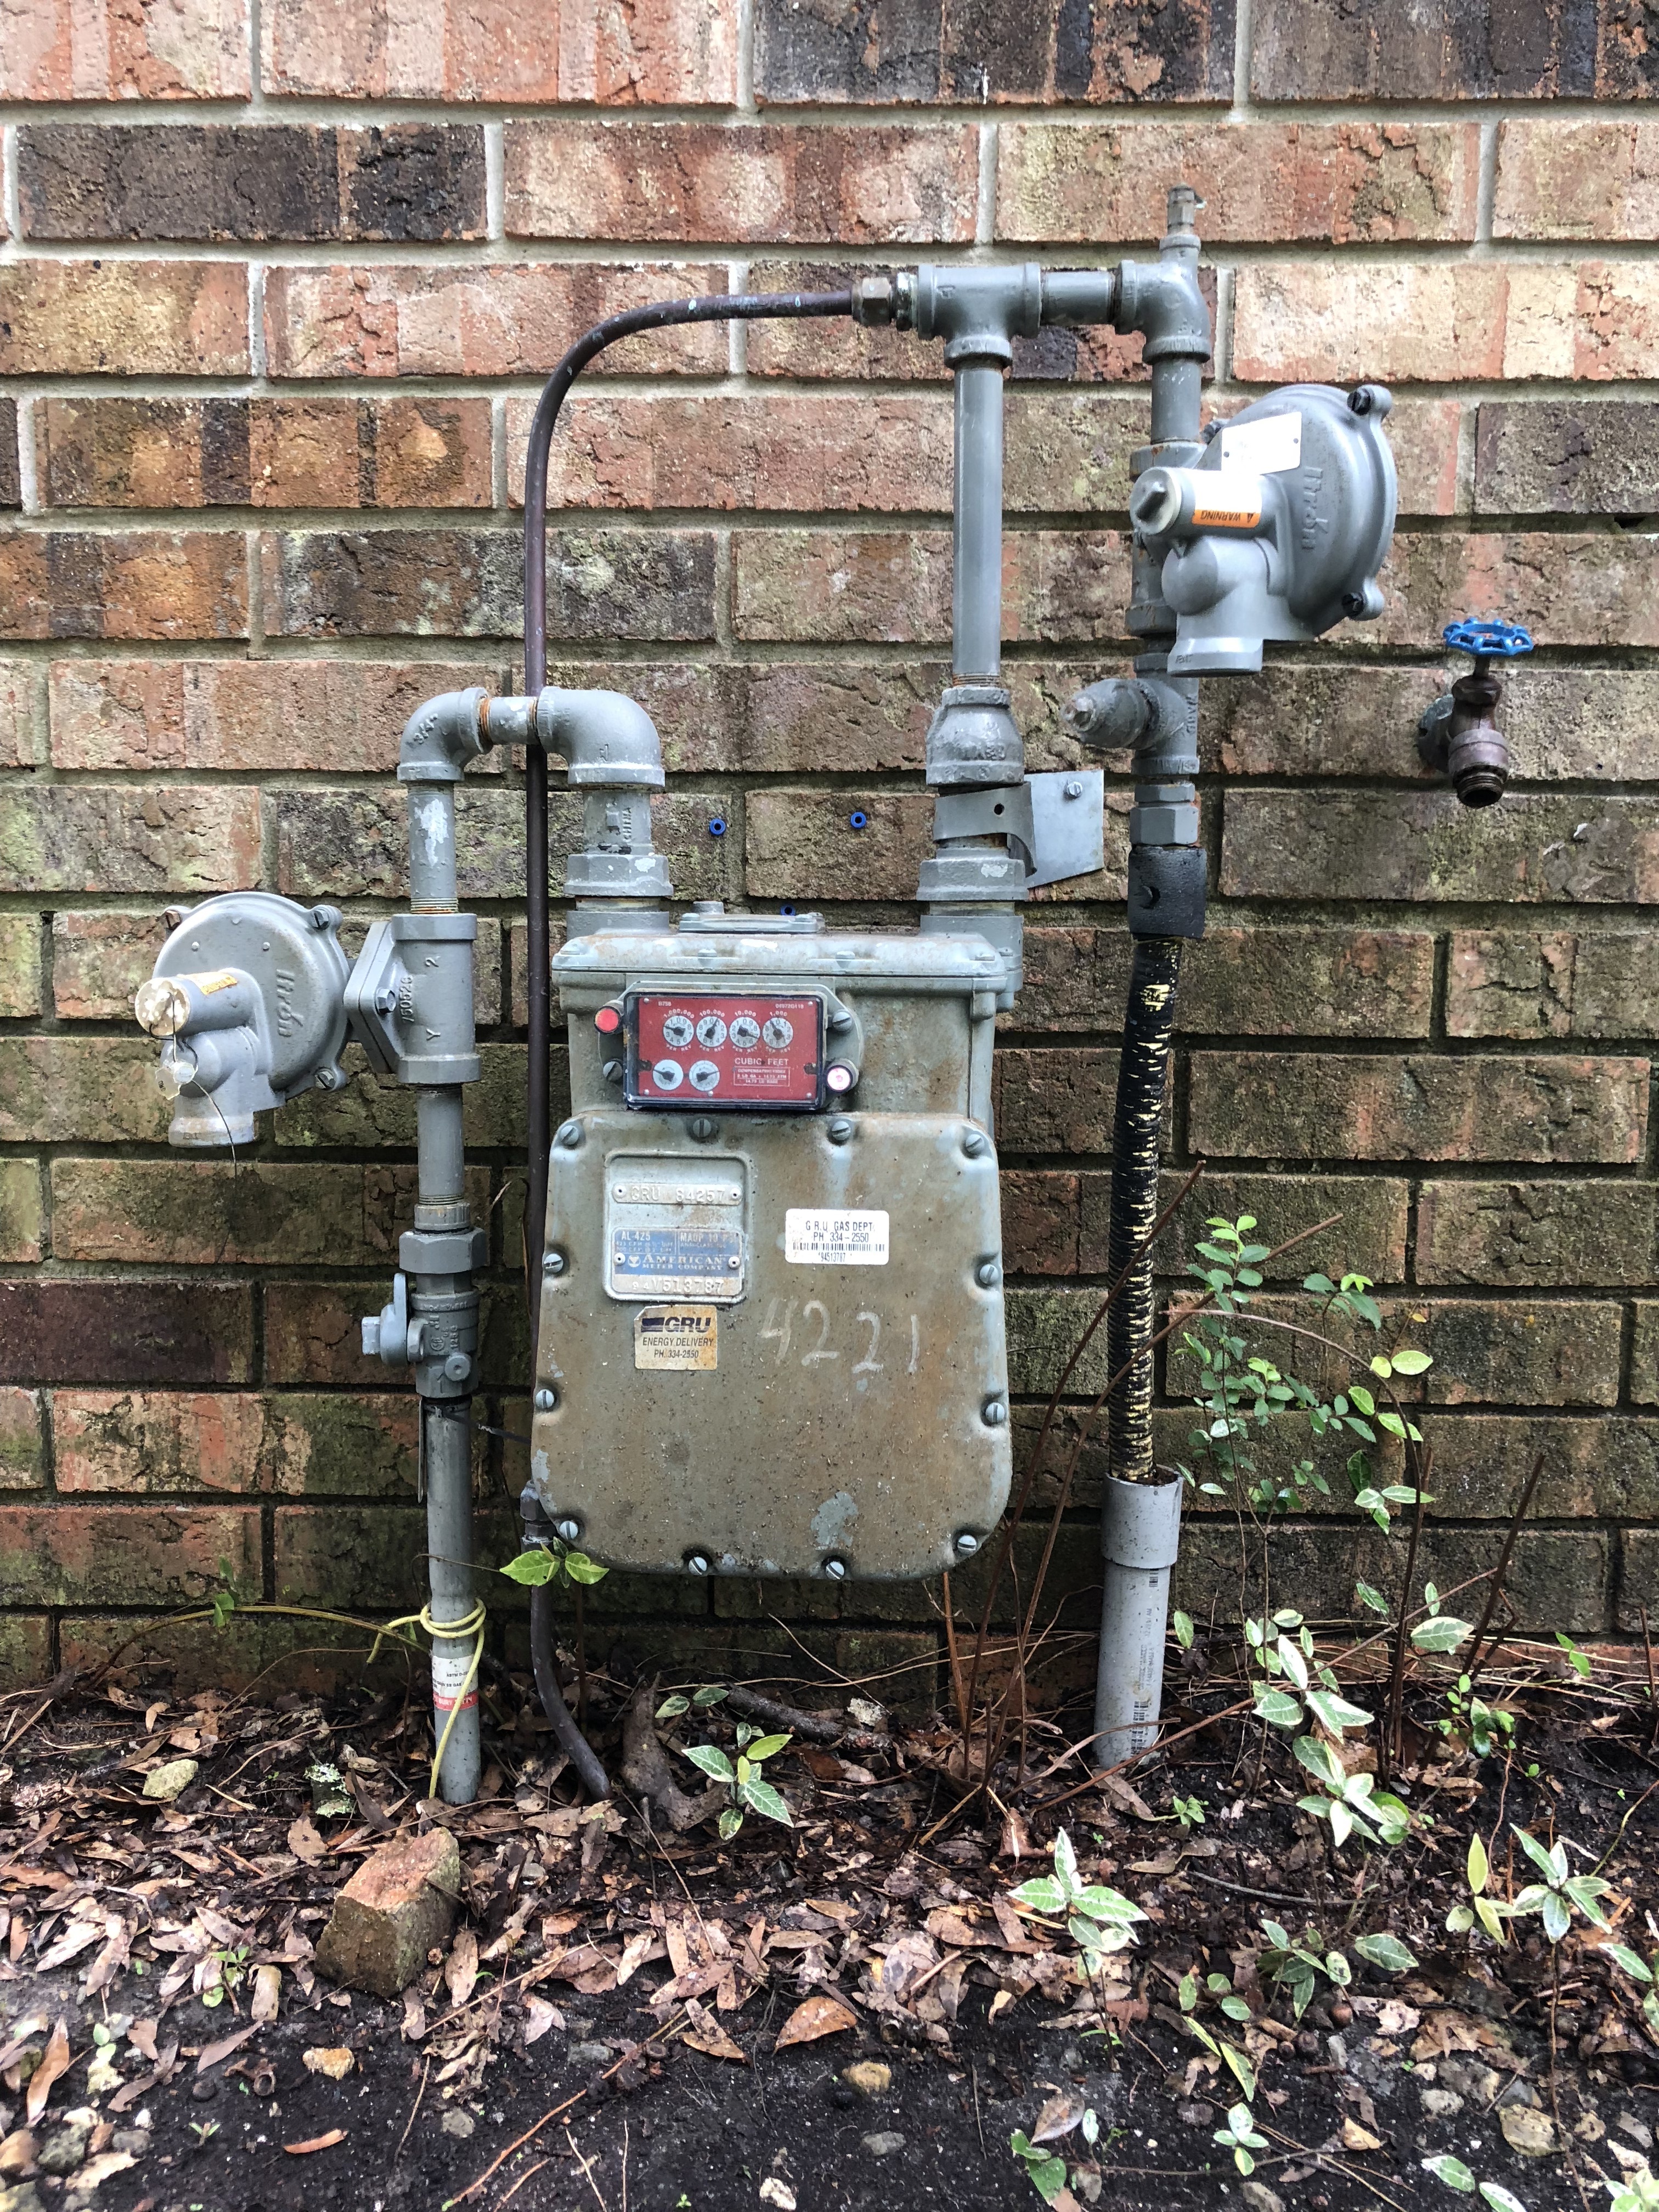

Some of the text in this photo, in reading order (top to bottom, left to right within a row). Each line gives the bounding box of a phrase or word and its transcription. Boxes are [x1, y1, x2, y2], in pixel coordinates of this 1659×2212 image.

[1200, 511, 1241, 522] WARNING
[622, 807, 631, 842] CHINA
[663, 1008, 695, 1019] 1,000,000
[699, 1009, 725, 1017] 100,000
[631, 1186, 726, 1202] GRU 84257
[834, 1221, 850, 1231] GAS
[621, 1231, 651, 1241] AL-425
[643, 1254, 724, 1264] AMERICAN
[664, 1317, 712, 1333] GRU
[760, 1297, 920, 1373] 4221
[642, 1337, 714, 1347] ENERGY DELIVERY
[668, 1350, 699, 1358] 334-2550
